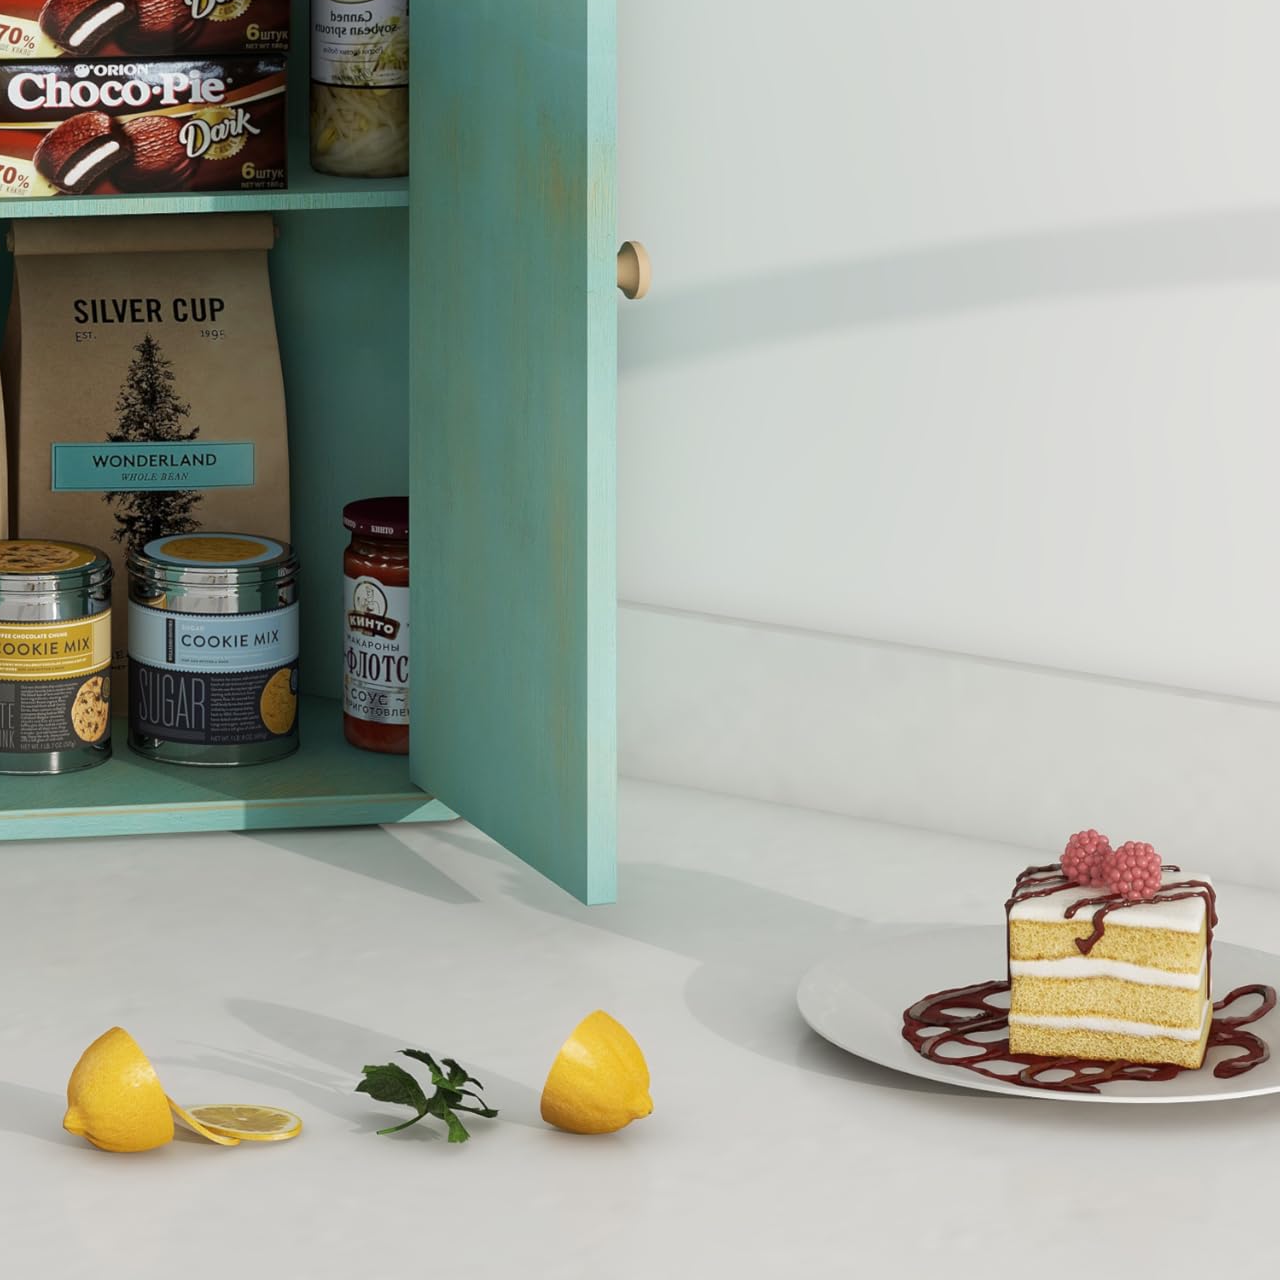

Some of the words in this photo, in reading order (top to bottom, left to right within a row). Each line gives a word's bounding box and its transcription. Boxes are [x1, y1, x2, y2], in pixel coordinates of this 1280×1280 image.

[247, 23, 260, 41] 6
[94, 64, 148, 77] ORION
[179, 108, 261, 159] Dark
[241, 161, 256, 180] 6
[73, 299, 163, 324] SILVER
[173, 298, 225, 322] CUP
[75, 331, 97, 343] EST.
[92, 454, 217, 468] WONDERLAND
[121, 472, 158, 482] WHOLE
[160, 472, 189, 481] BEAN
[350, 615, 394, 635] КИНТО
[12, 632, 47, 640] CHOCOLATE
[64, 637, 90, 653] MIX
[181, 634, 249, 648] COOKIE
[254, 629, 279, 646] MIX
[139, 668, 205, 729] SUGAR
